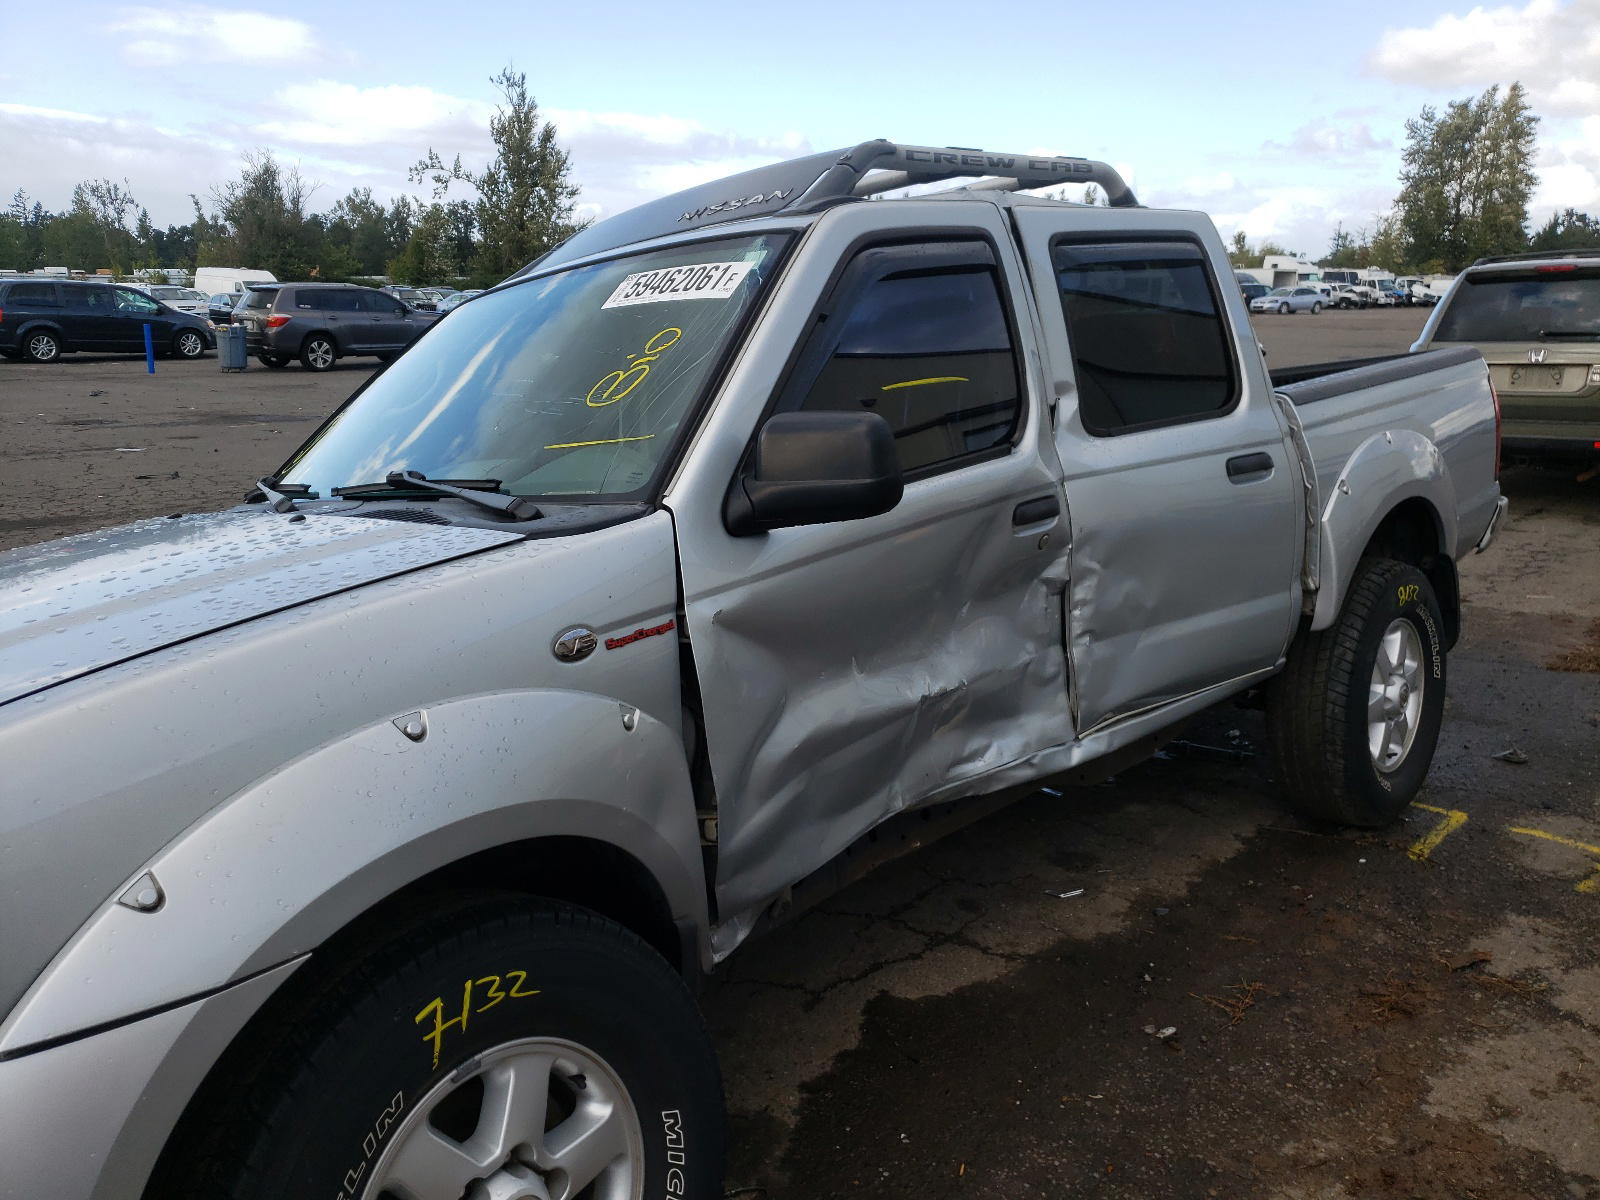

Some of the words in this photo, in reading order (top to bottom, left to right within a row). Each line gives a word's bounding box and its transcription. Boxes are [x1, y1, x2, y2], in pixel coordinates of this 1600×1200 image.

[905, 149, 1016, 169] CREW
[1028, 159, 1093, 174] CAB
[676, 187, 794, 223] NISSAN
[623, 264, 733, 299] 59462061
[414, 970, 541, 1071] 7/32
[336, 1090, 404, 1200] LIN
[661, 1109, 685, 1200] MIC
